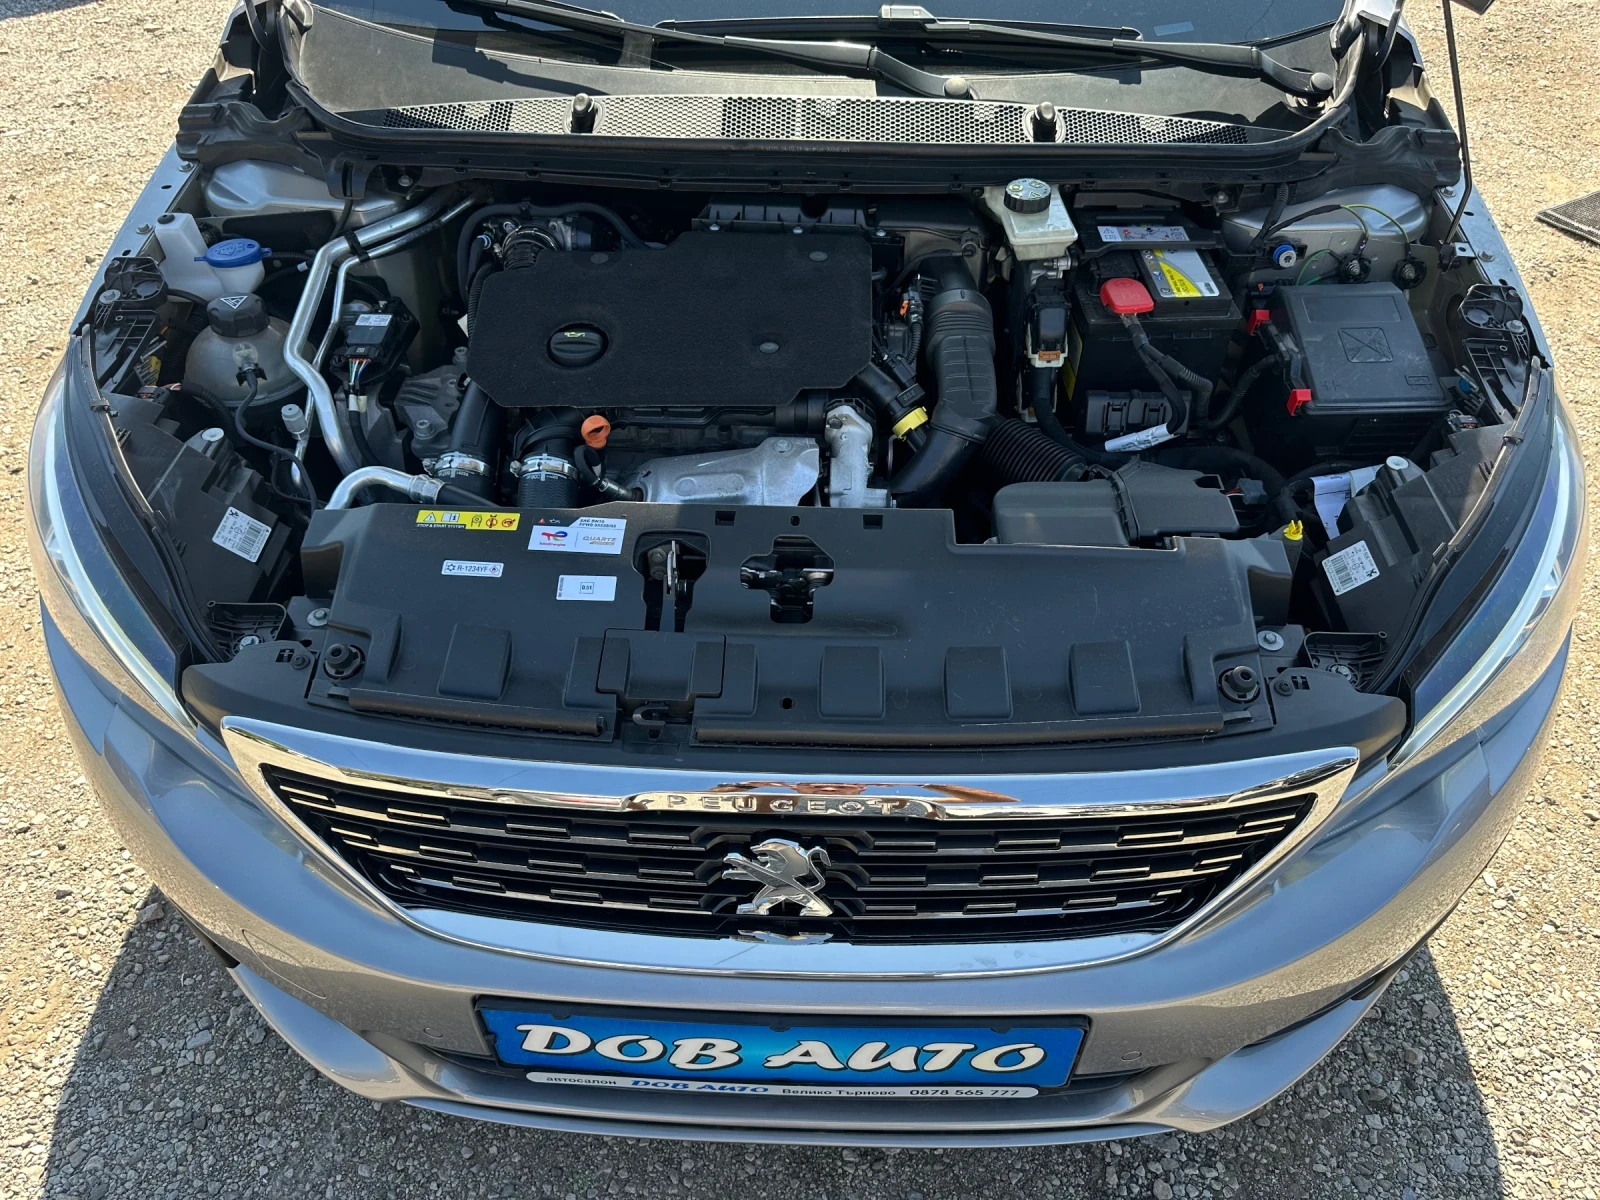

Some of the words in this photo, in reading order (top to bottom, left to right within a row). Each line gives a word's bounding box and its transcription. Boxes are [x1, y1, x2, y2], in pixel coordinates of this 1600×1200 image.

[456, 564, 488, 573] R-1234YF
[667, 794, 900, 815] PEUGEOT
[516, 1024, 742, 1070] DOB
[546, 1075, 617, 1086] автосалон
[630, 1079, 690, 1090] DOB
[836, 1089, 897, 1097] Търново
[909, 1089, 950, 1097] 0878
[954, 1089, 984, 1097] 565
